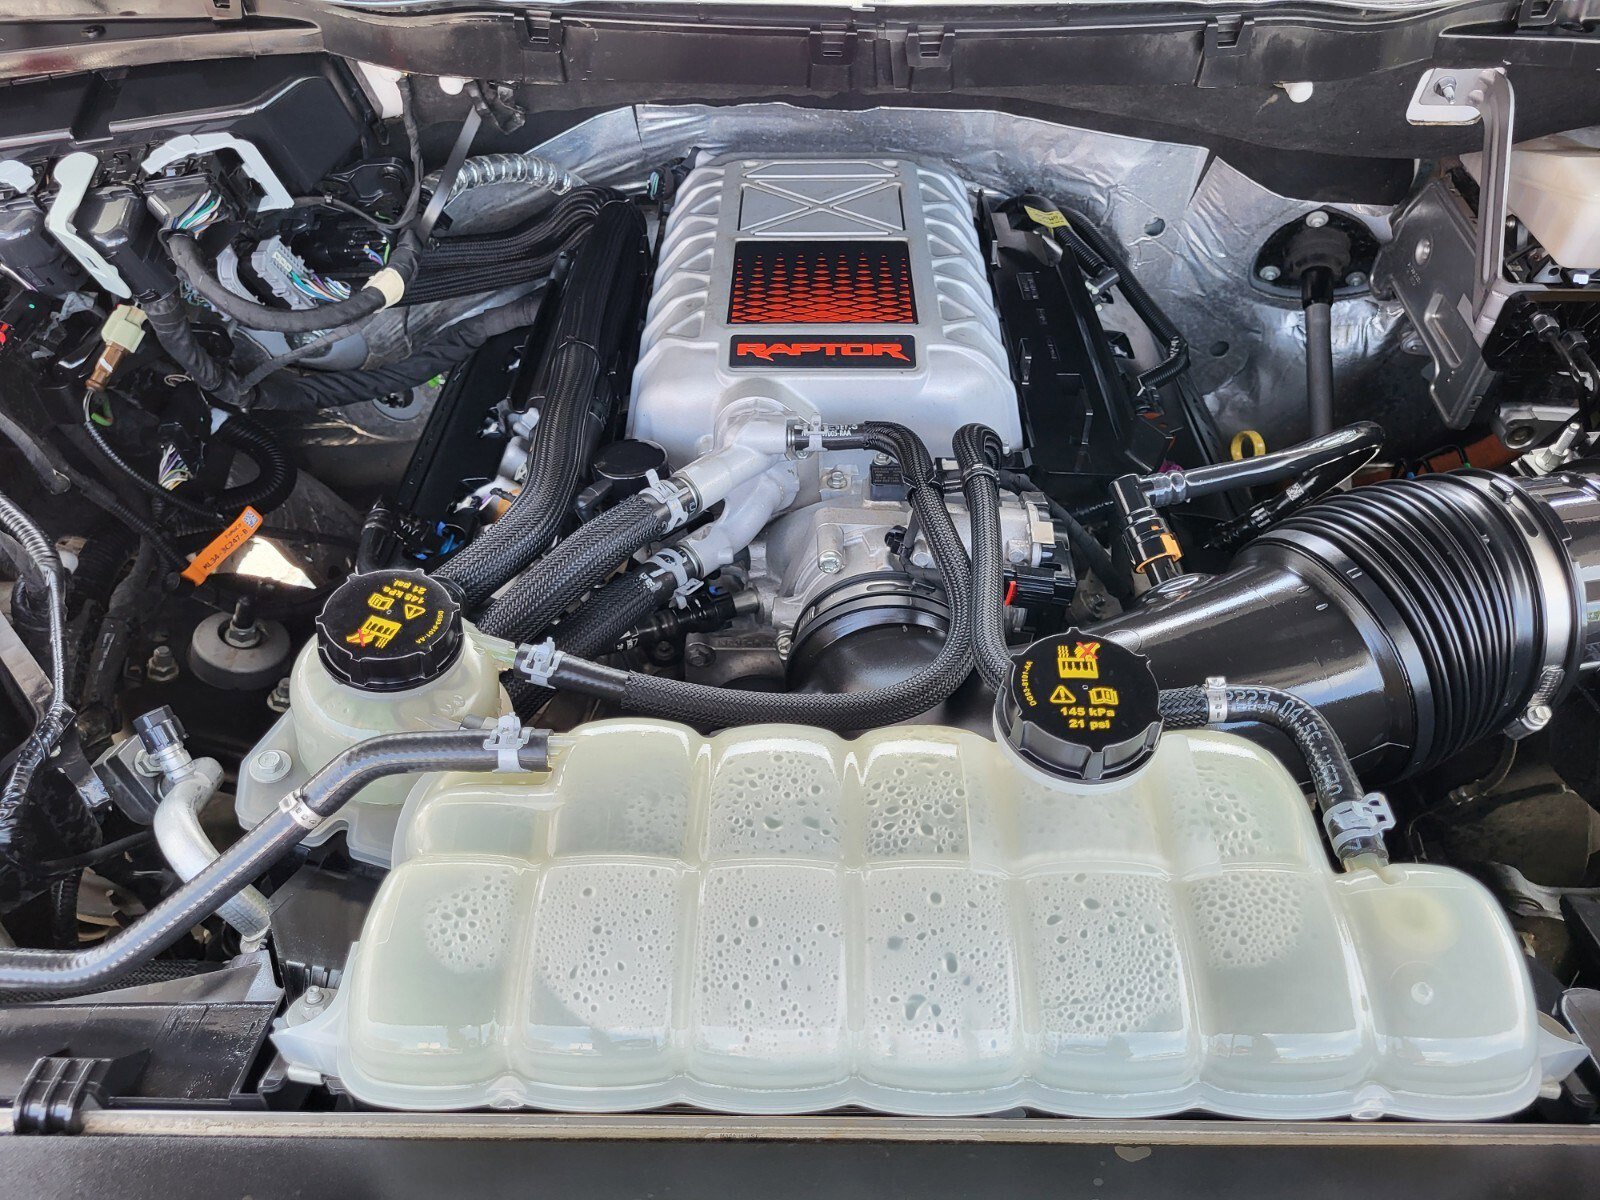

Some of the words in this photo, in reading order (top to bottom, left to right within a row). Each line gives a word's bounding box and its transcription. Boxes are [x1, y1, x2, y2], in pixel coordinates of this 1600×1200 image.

[737, 343, 911, 362] RAPTOR
[393, 579, 412, 590] psi
[412, 585, 428, 595] 21
[382, 585, 405, 598] kPa
[404, 592, 426, 604] 145
[1060, 706, 1086, 717] 145
[1088, 706, 1116, 717] kPa
[1068, 719, 1085, 729] 21
[1089, 719, 1111, 731] psi
